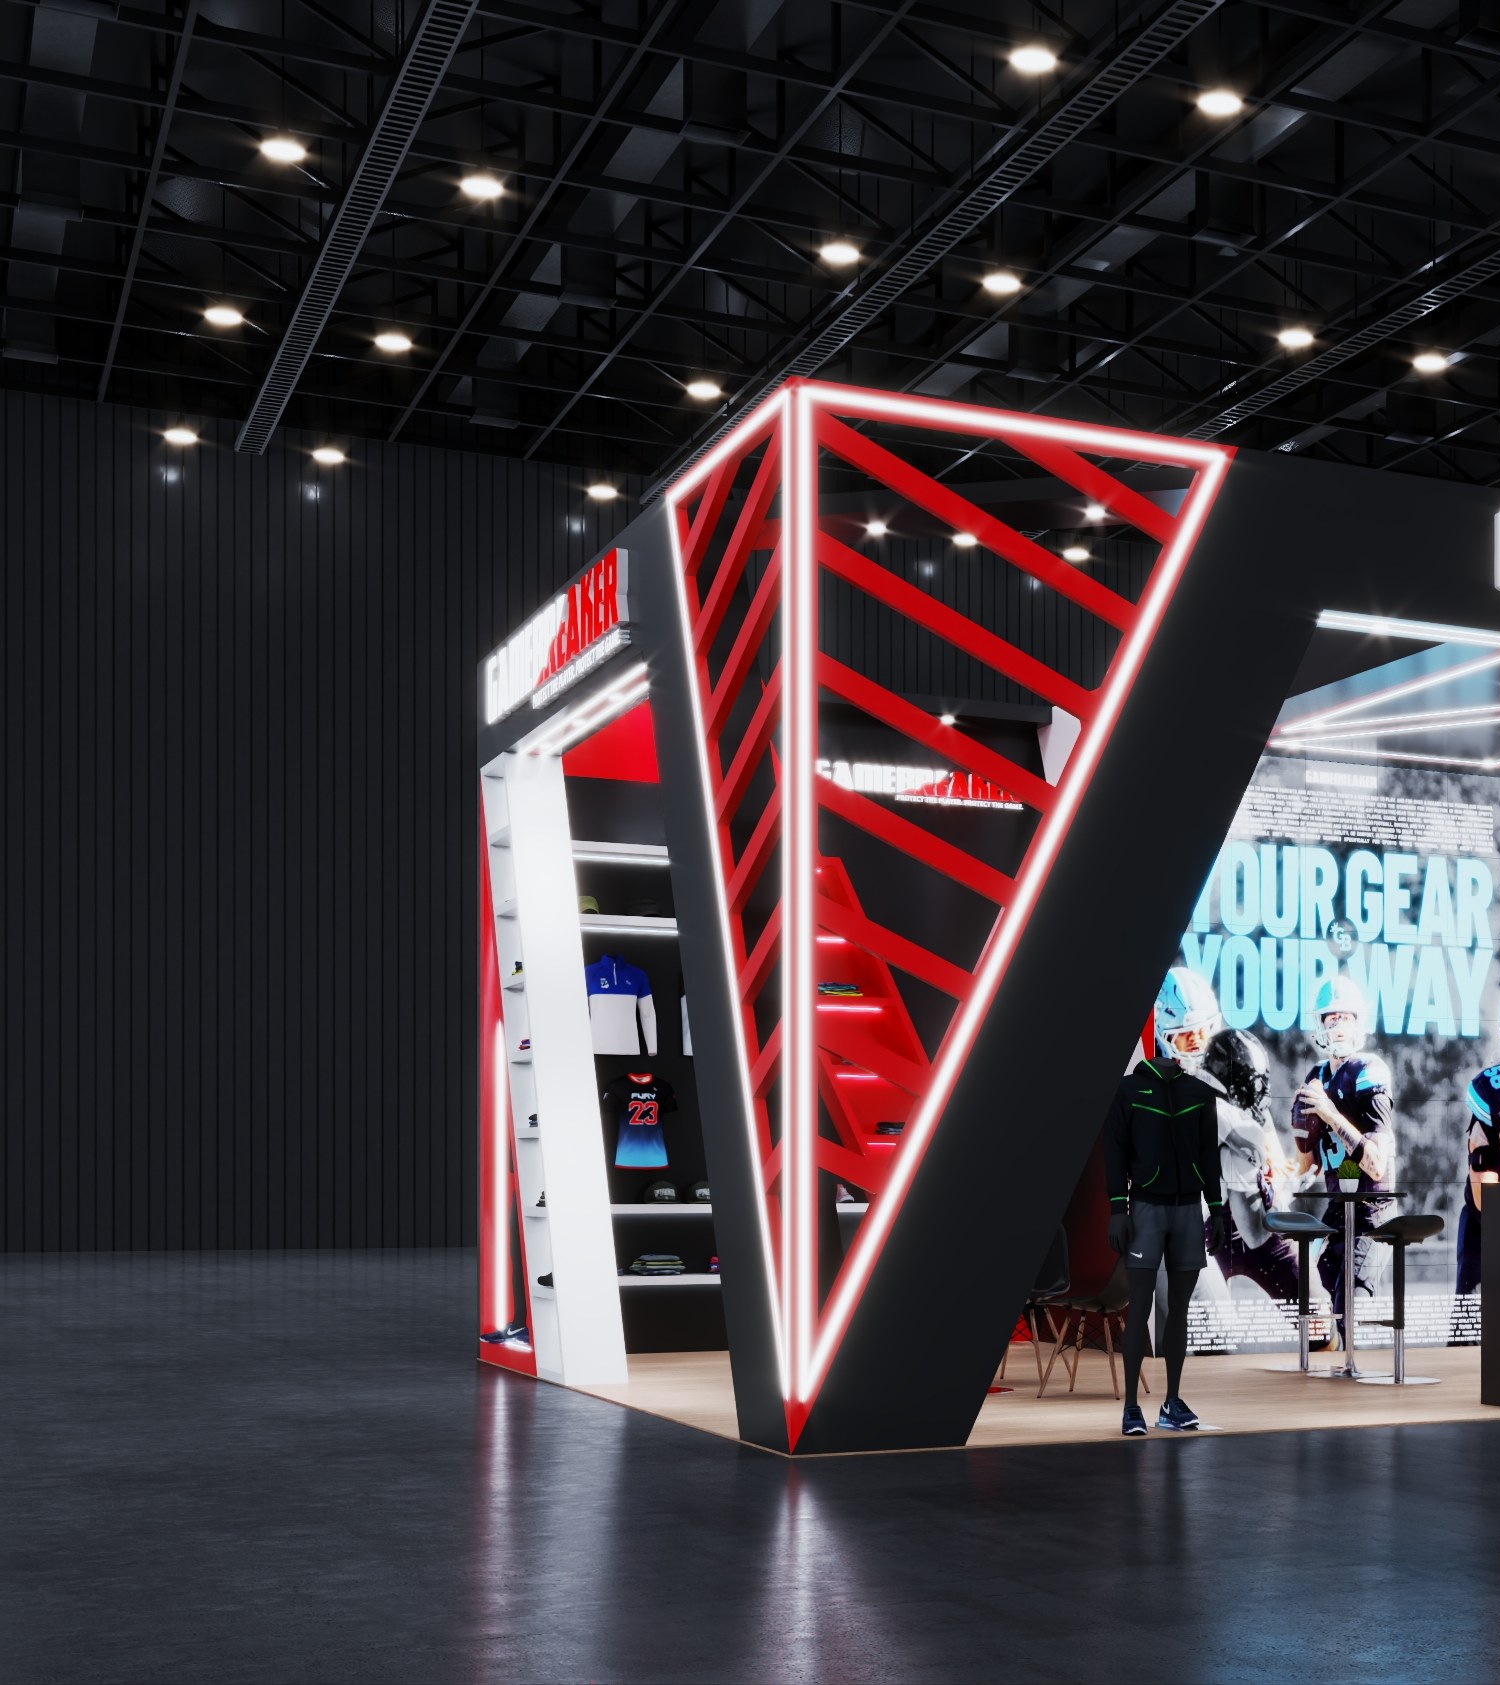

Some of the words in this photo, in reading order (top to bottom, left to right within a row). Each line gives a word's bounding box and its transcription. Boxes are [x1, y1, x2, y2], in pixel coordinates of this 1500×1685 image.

[1346, 848, 1493, 949] GEAR
[1345, 941, 1494, 1037] WAY
[628, 1101, 659, 1126] 23
[630, 1092, 657, 1100] FURY
